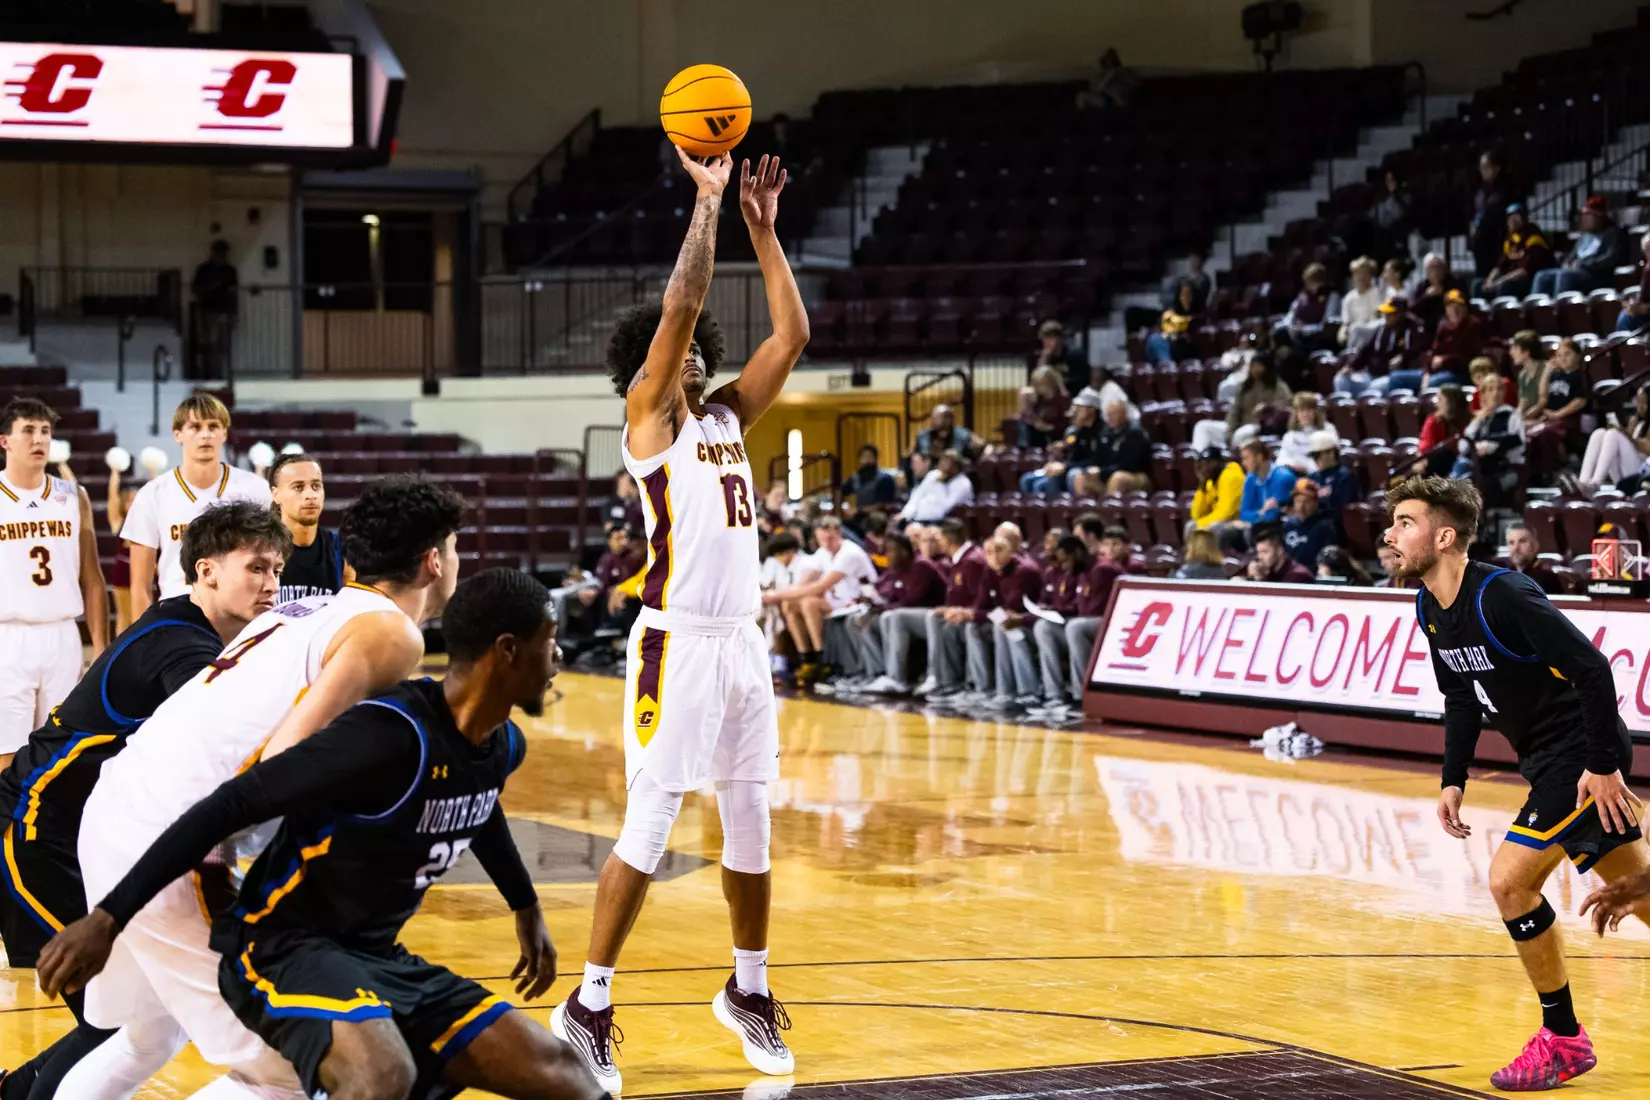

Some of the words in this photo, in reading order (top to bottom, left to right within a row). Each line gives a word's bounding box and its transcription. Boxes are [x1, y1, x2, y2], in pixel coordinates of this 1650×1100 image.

[719, 472, 753, 529] 13
[0, 520, 72, 542] CHIPPEWAS
[29, 545, 53, 587] 3
[1175, 605, 1428, 696] WELCOME
[1462, 645, 1495, 672] PARK
[1472, 679, 1500, 714] 4
[415, 793, 473, 834] NORTH
